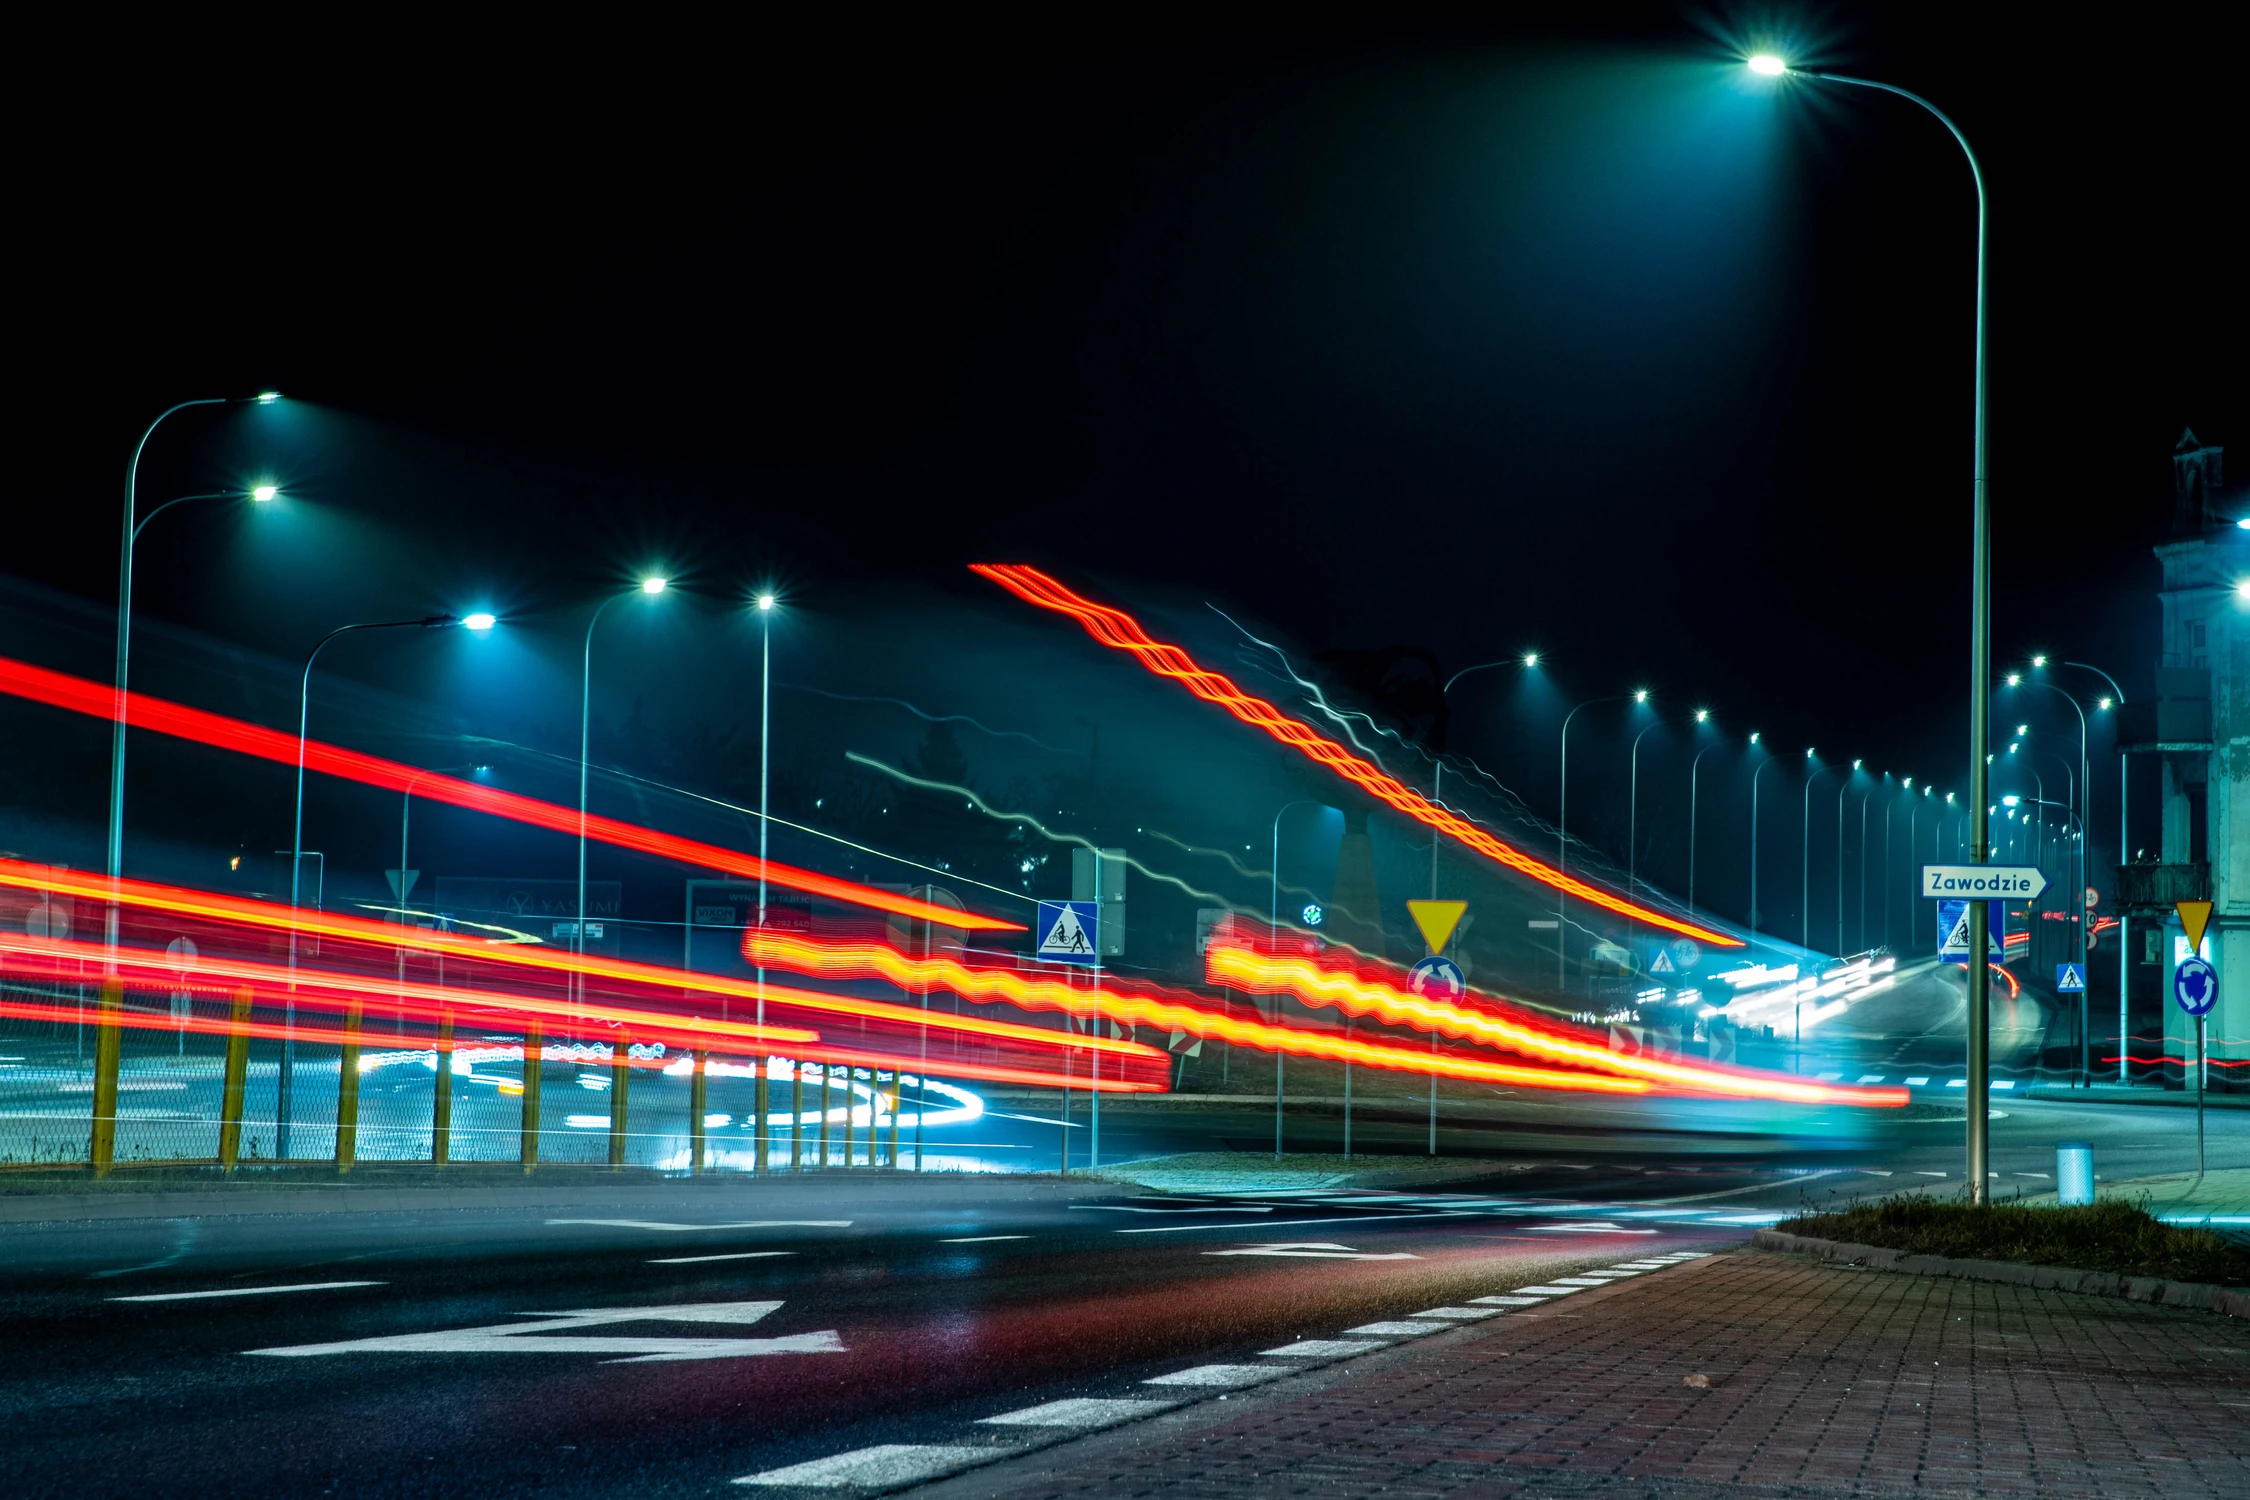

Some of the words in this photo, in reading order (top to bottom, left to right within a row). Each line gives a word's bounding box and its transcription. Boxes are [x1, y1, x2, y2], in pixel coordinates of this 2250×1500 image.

[1931, 873, 2031, 891] Zawodzie
[728, 893, 776, 903] WYNAM
[698, 908, 733, 917] VIXON
